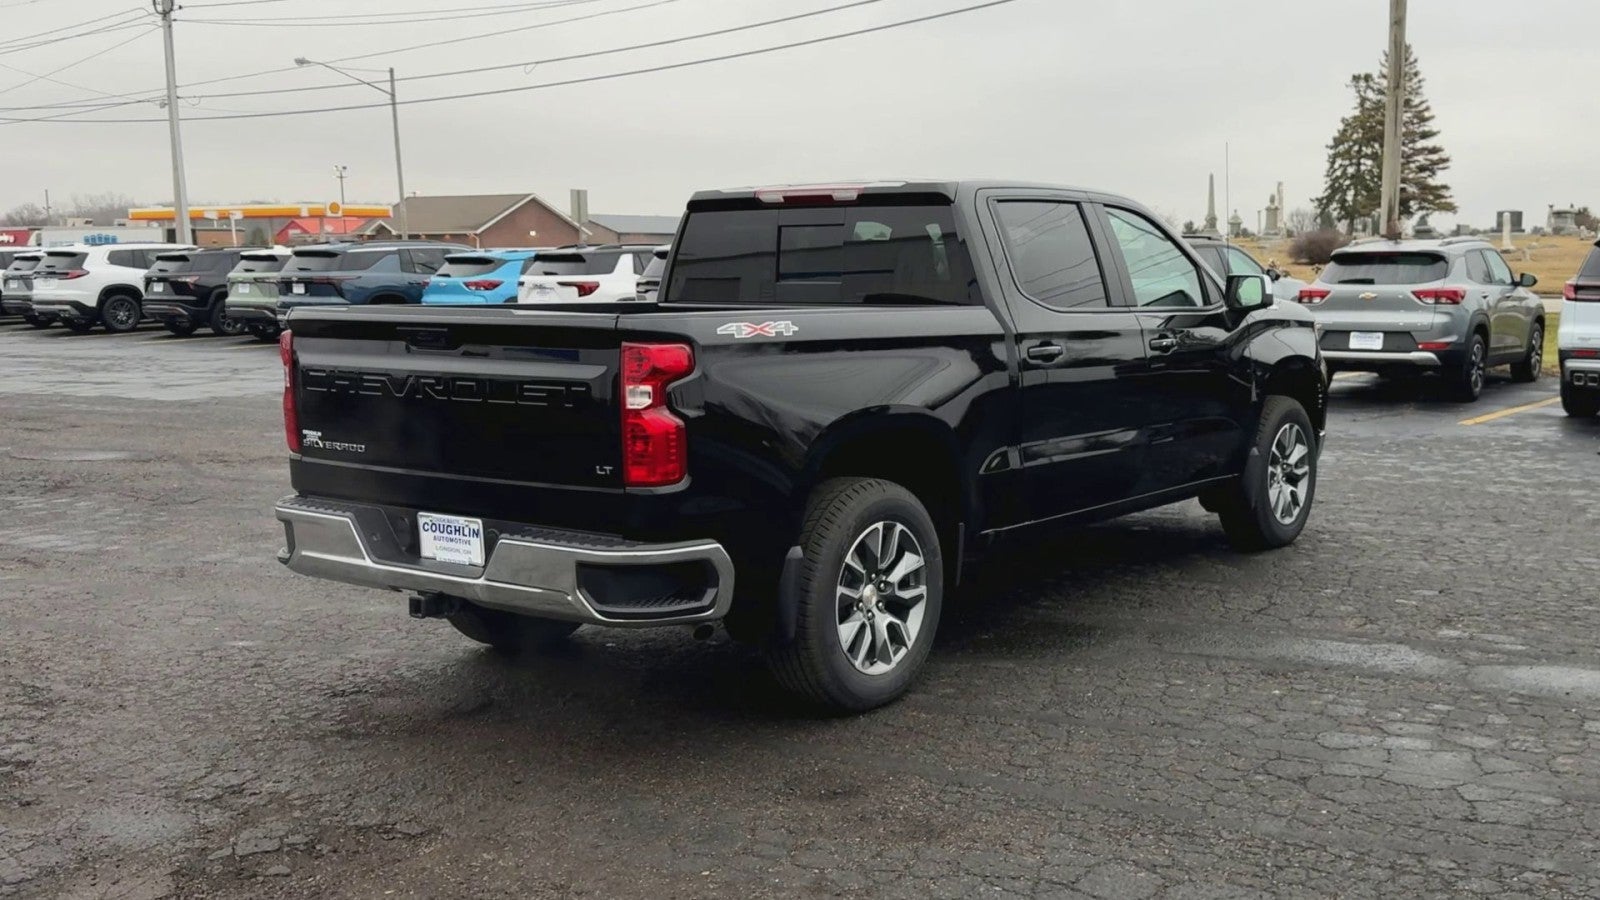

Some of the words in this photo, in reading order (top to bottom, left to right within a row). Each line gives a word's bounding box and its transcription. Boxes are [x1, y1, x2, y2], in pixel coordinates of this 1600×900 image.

[304, 368, 589, 408] CHEVROLET
[303, 438, 366, 452] SILVERADO
[595, 465, 613, 475] LT
[422, 521, 480, 539] COUGHLIN
[433, 535, 471, 546] AUTOMOTIVE
